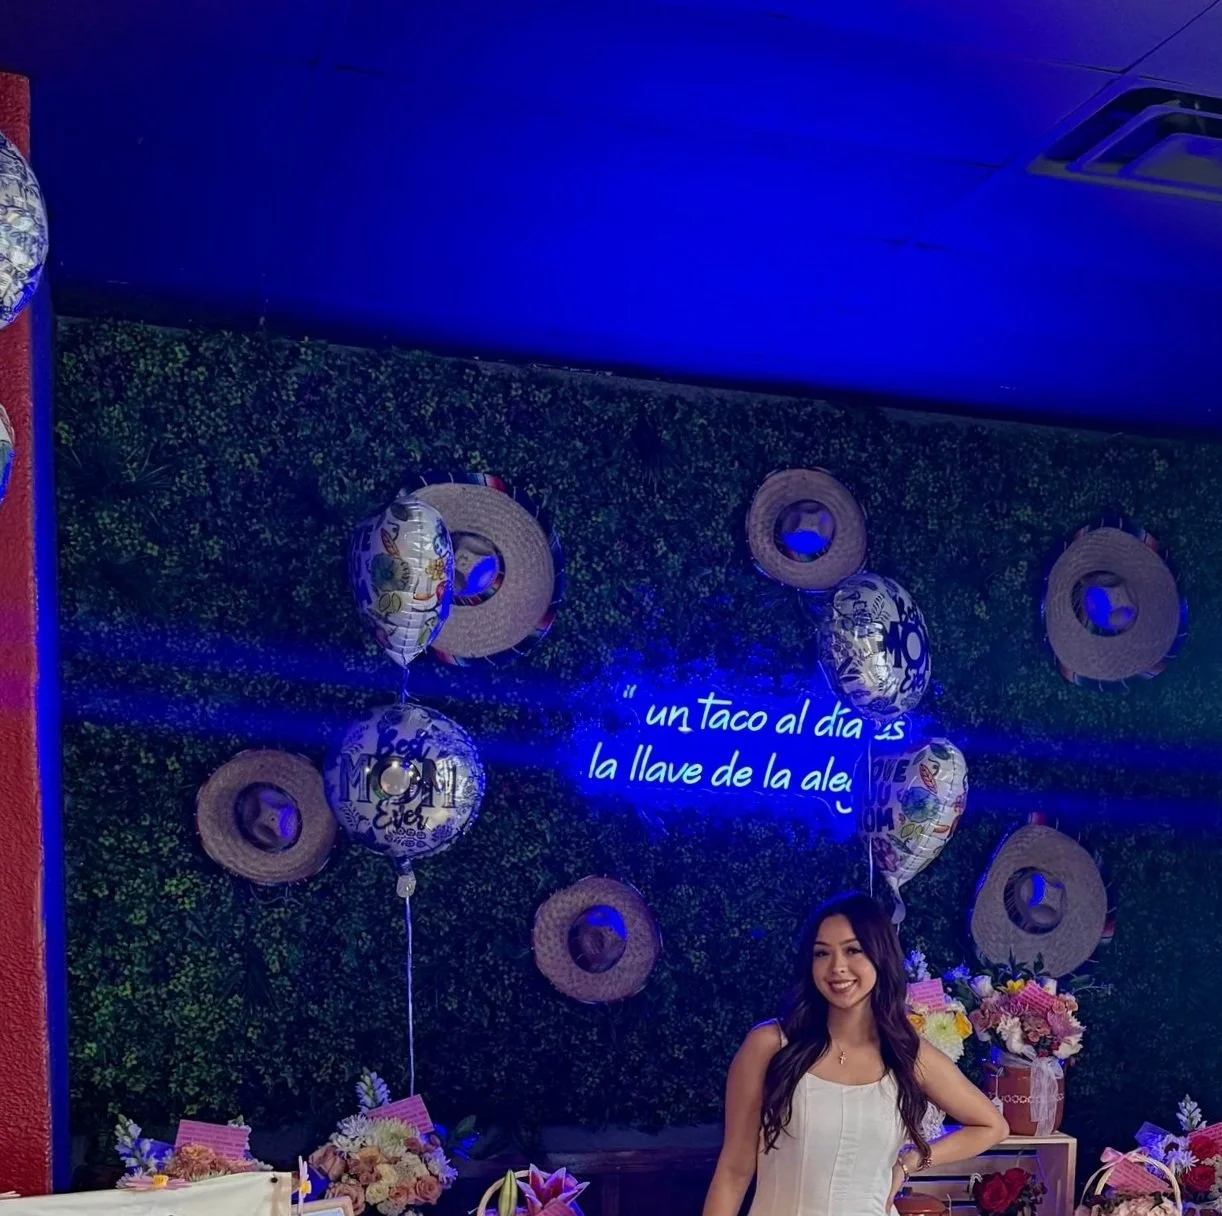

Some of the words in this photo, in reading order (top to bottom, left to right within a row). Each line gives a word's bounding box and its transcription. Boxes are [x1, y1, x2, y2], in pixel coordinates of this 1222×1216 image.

[645, 704, 694, 734] un
[697, 691, 768, 732] taco
[775, 698, 810, 735] al
[588, 741, 618, 781] la
[629, 744, 703, 784] llave
[711, 750, 753, 788] de
[763, 752, 792, 790] la
